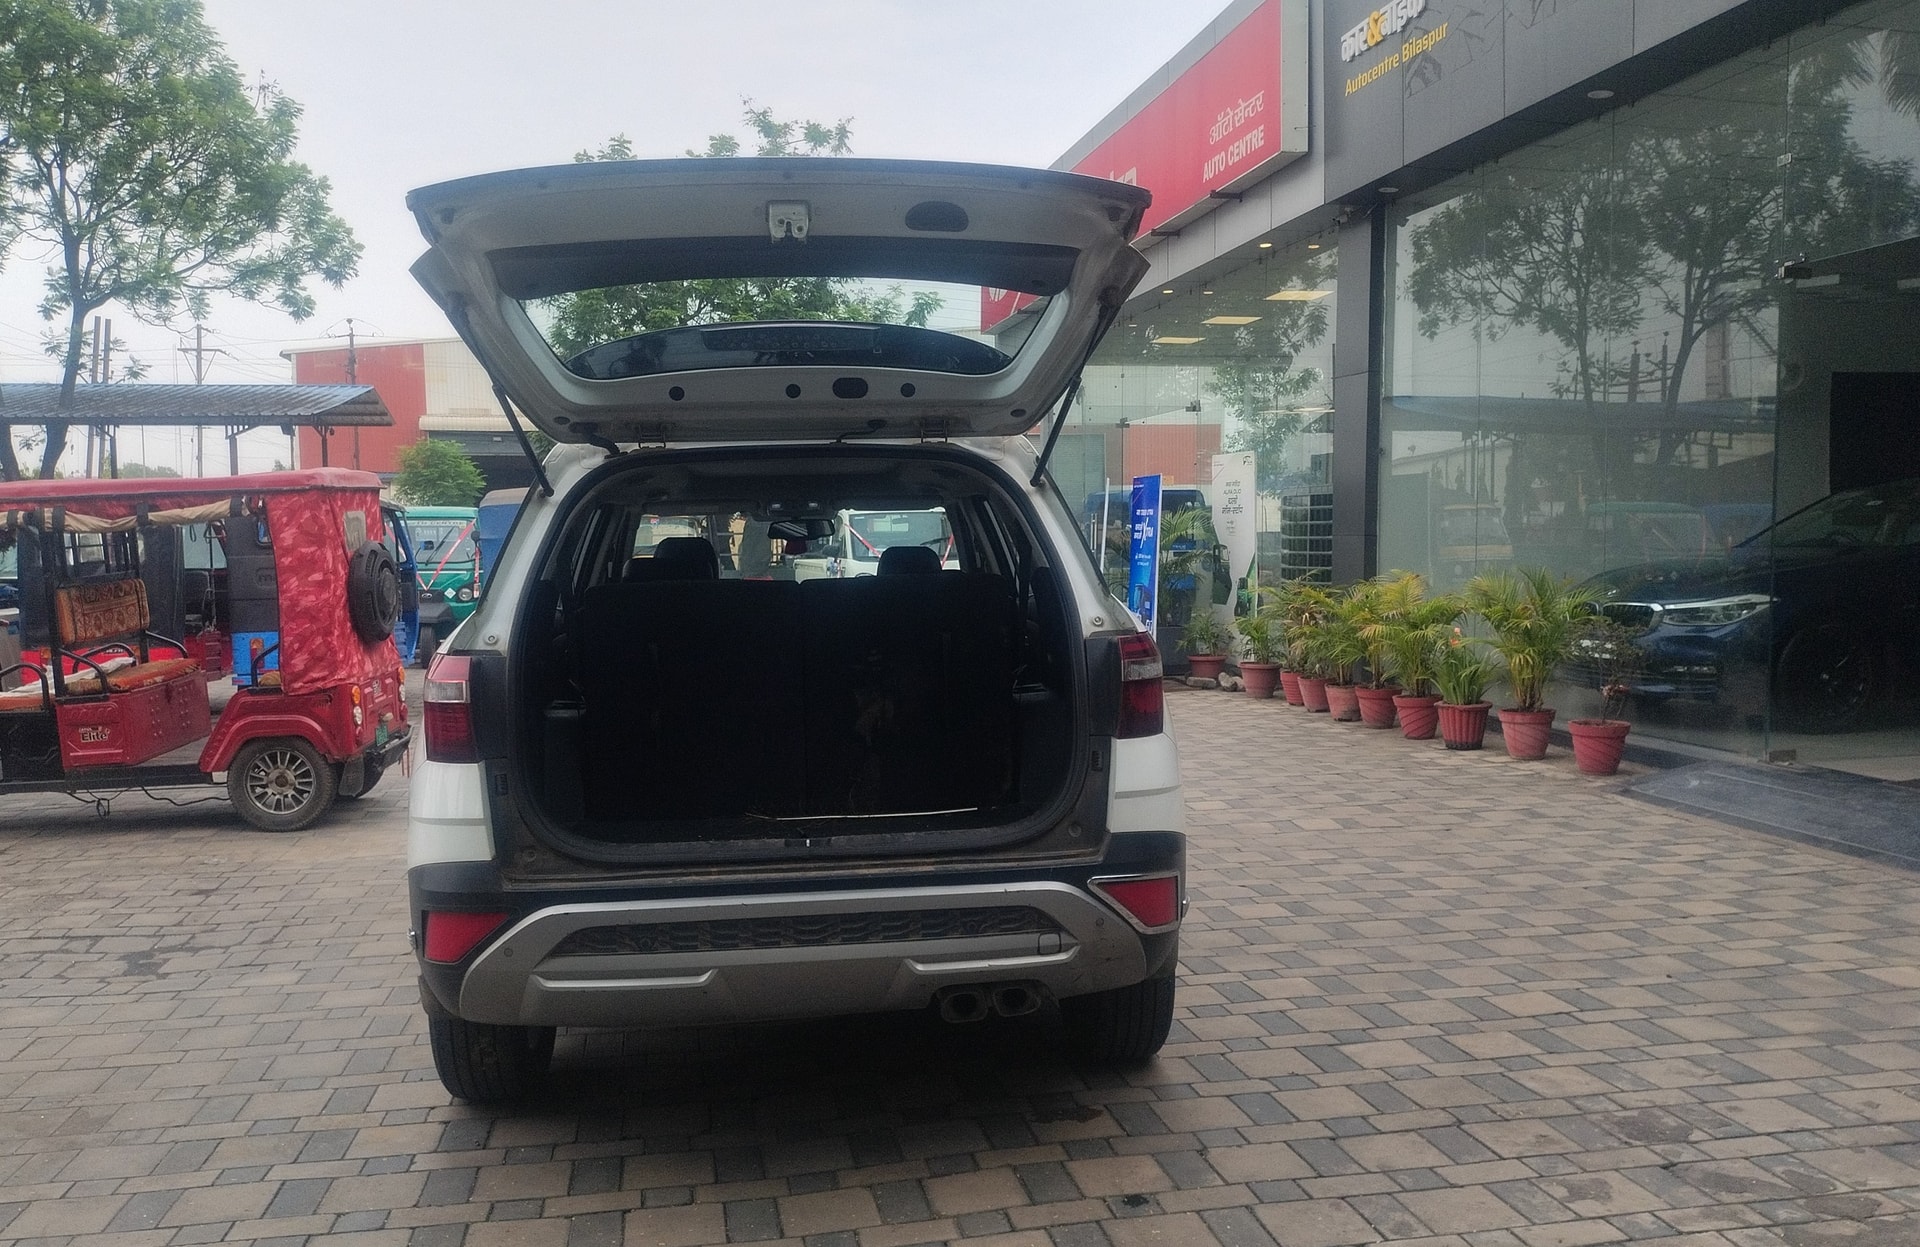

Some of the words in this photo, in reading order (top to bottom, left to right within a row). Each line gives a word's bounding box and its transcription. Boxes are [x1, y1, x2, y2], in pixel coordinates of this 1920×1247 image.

[1344, 52, 1400, 97] Autocentre
[1402, 22, 1448, 63] Bilaspur
[1209, 106, 1233, 145] ऑटो
[1234, 90, 1264, 128] सेन्टर
[1202, 151, 1226, 183] AUTO
[1227, 124, 1265, 166] CENTRE
[81, 731, 108, 742] Elite
